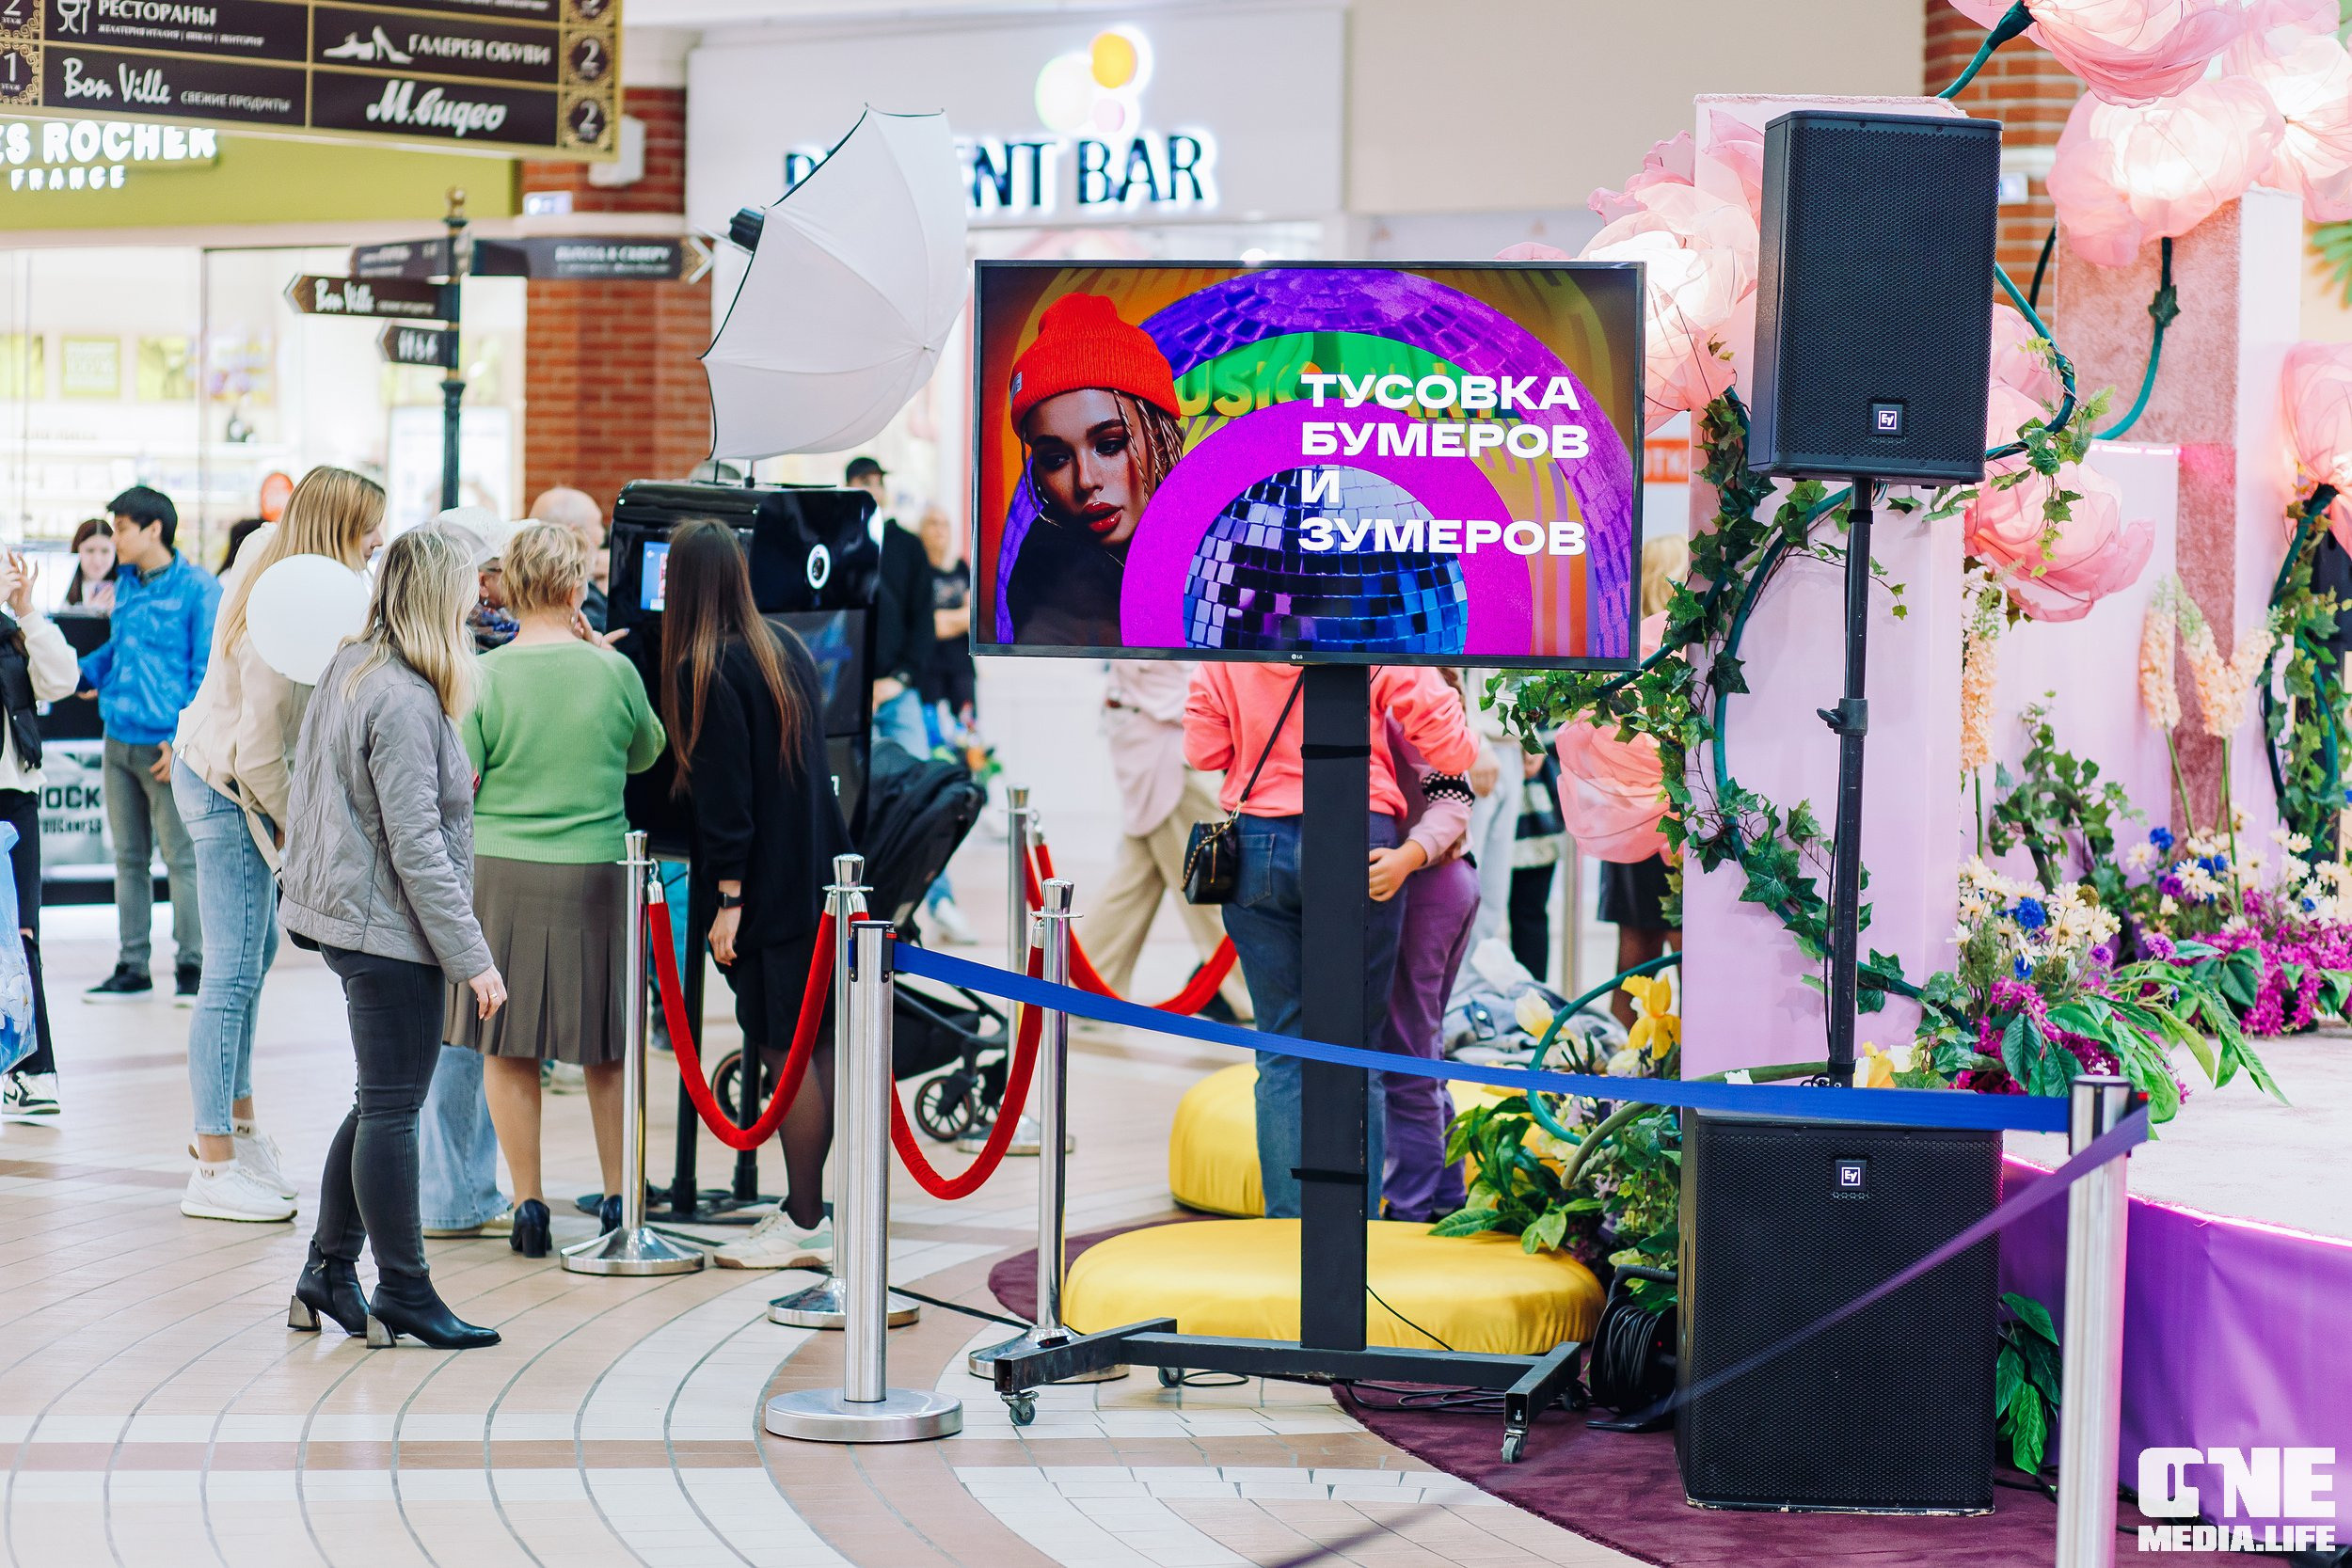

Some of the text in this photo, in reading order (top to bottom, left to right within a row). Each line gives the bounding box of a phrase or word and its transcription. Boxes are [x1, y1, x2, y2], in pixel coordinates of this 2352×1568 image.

[98, 0, 217, 26] РЕСТОРАНЫ
[4, 52, 16, 83] 1
[485, 40, 551, 66] ОБУВИ
[581, 38, 601, 71] 2
[62, 57, 172, 104] Bon Ville
[579, 100, 599, 134] 2
[0, 119, 217, 165] S ROCHER
[10, 165, 125, 191] FRANCE
[1077, 135, 1205, 206] BAR
[314, 278, 344, 312] Bon
[344, 280, 375, 313] Ville
[1173, 359, 1323, 417] USIC
[1300, 372, 1580, 411] ТУСОВКА
[1301, 421, 1589, 459] БУМЕРОВ
[1301, 469, 1340, 503] И
[1298, 517, 1586, 555] ЗУМЕРОВ
[38, 785, 101, 809] OCK
